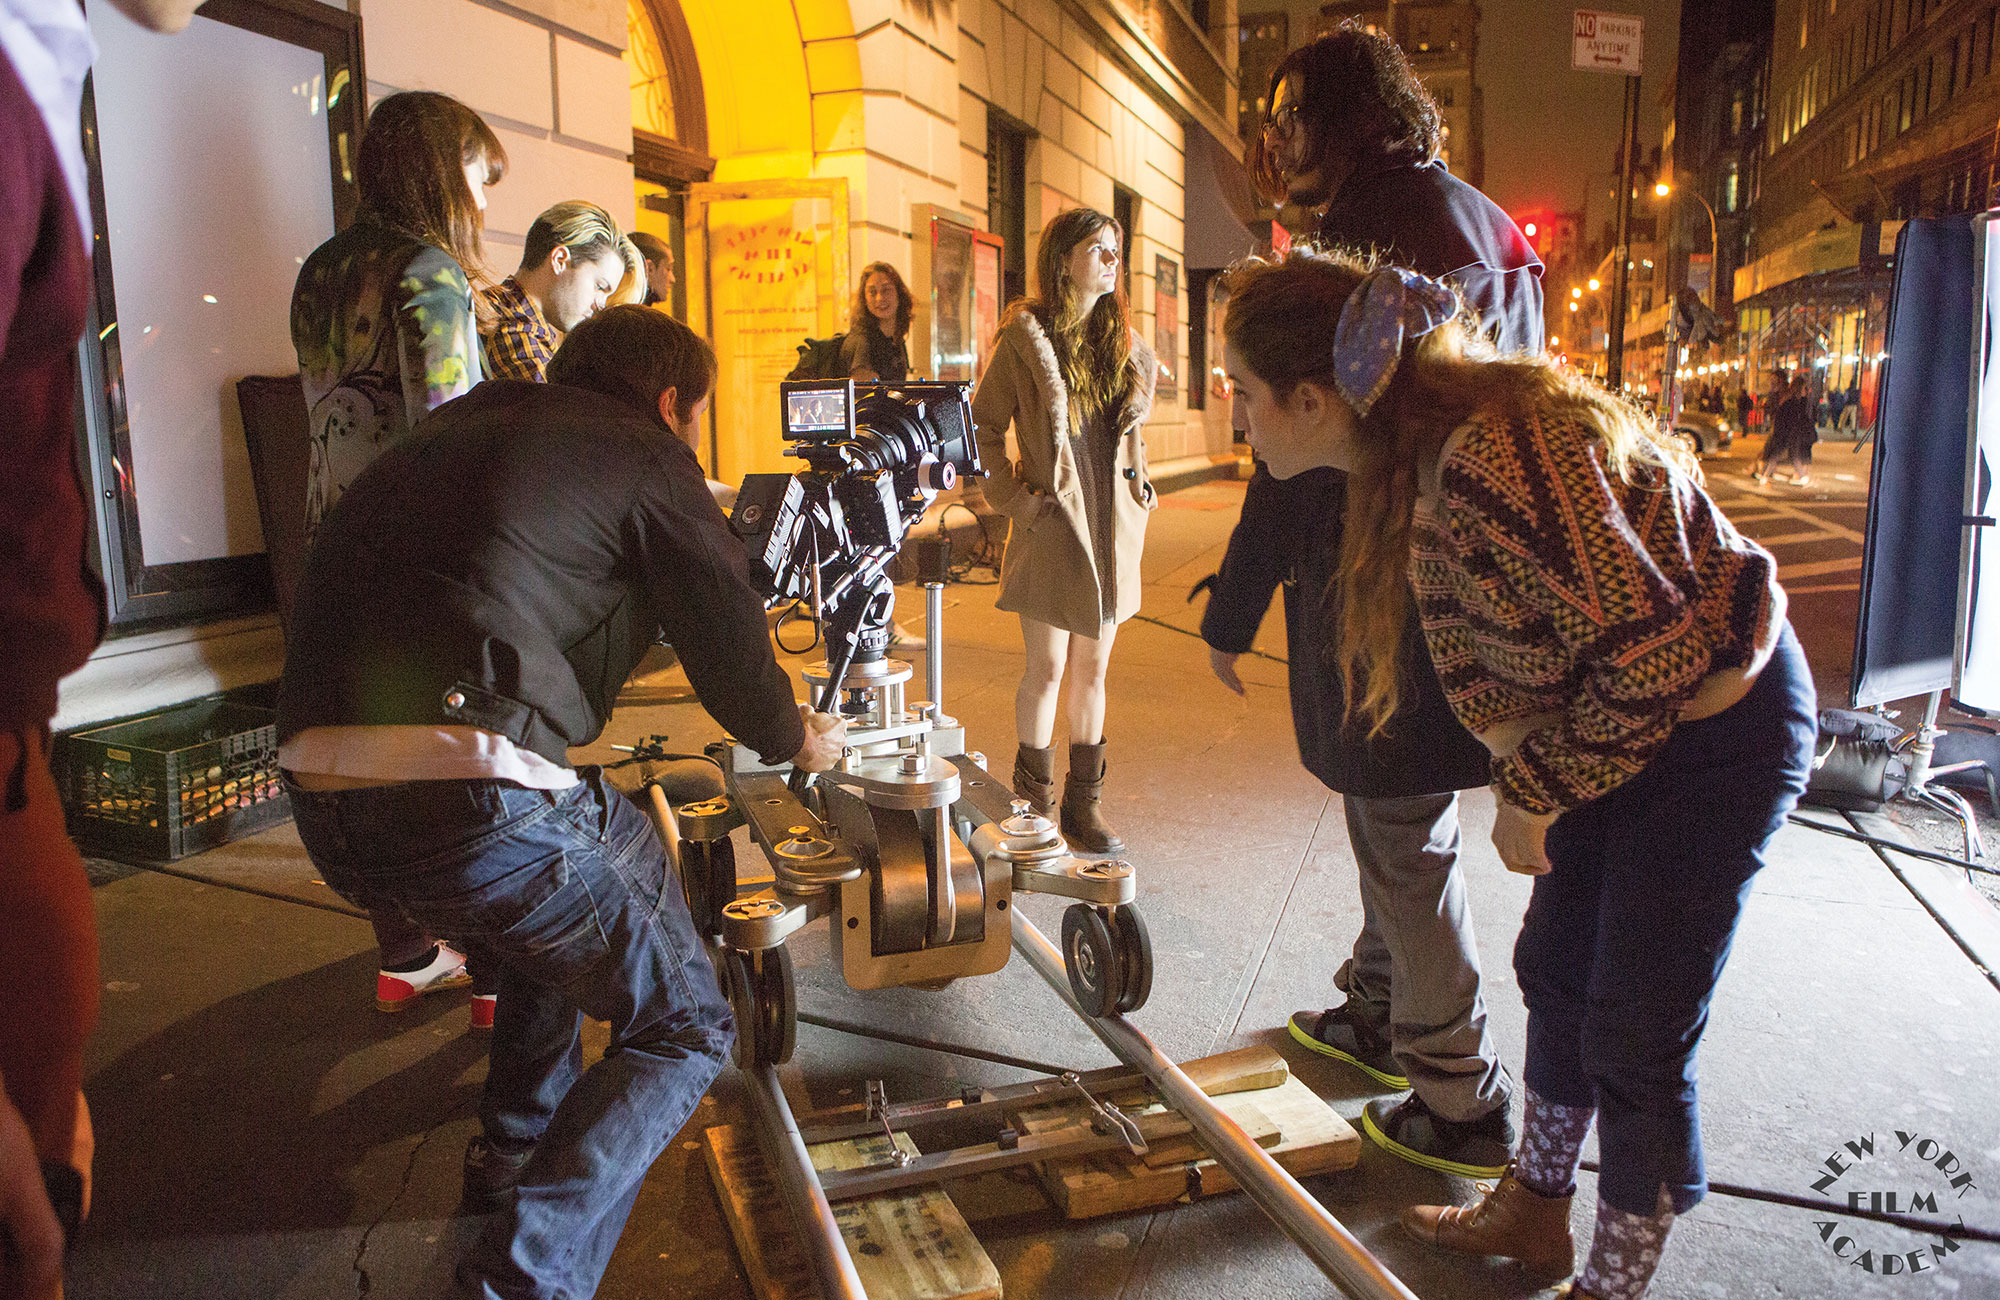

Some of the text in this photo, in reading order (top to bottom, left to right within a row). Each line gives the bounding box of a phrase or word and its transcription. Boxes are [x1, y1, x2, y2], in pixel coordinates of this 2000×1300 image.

[1576, 13, 1637, 38] NO PARKING
[1586, 41, 1630, 56] ANYTIME
